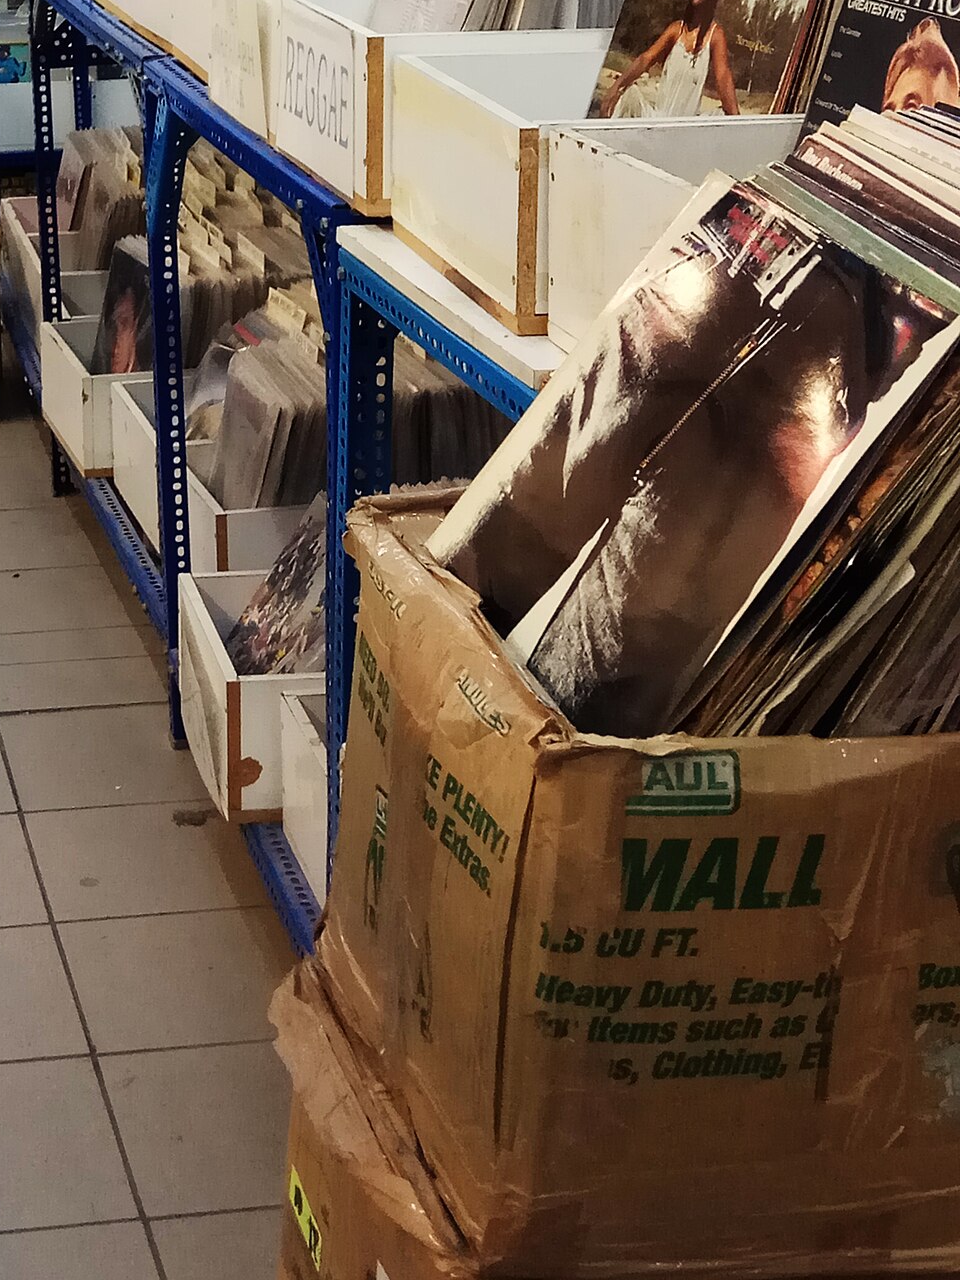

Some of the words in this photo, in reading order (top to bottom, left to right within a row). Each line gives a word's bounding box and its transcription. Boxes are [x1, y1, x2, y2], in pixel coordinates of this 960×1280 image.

[886, 6, 908, 24] HITS
[283, 35, 349, 150] REGGAE
[643, 760, 729, 792] AUL
[442, 771, 510, 864] PLENTY!
[439, 815, 492, 899] Extras.
[622, 833, 826, 913] MALL
[596, 927, 646, 959] CU
[651, 927, 699, 959] FT.
[535, 972, 633, 1014] Heavy
[637, 979, 718, 1012] Duty,
[586, 1015, 678, 1045] Items
[686, 1013, 764, 1043] such
[769, 1015, 809, 1040] as
[651, 1048, 788, 1081] Clothing,
